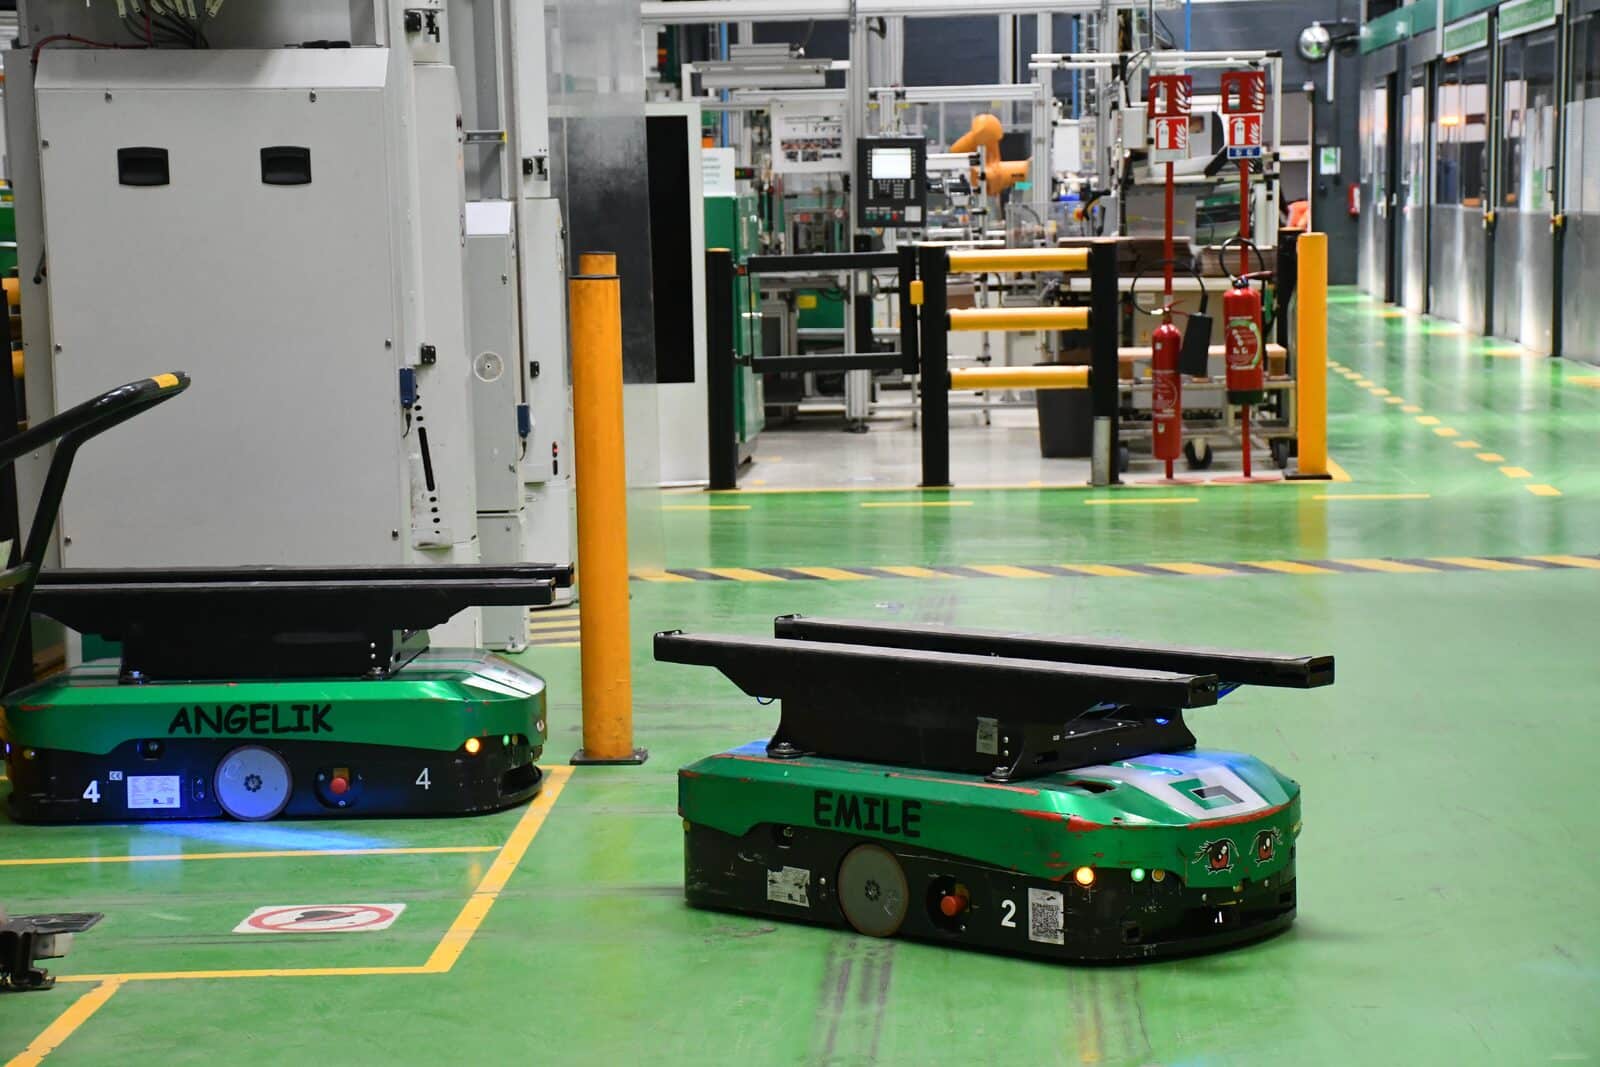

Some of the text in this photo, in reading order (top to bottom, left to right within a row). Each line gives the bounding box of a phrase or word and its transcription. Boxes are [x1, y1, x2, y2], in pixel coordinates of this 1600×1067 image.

[168, 704, 334, 735] ANGELIK
[82, 780, 101, 804] 4
[415, 767, 432, 790] 4
[814, 790, 922, 837] EMILE
[1001, 899, 1017, 928] 2
